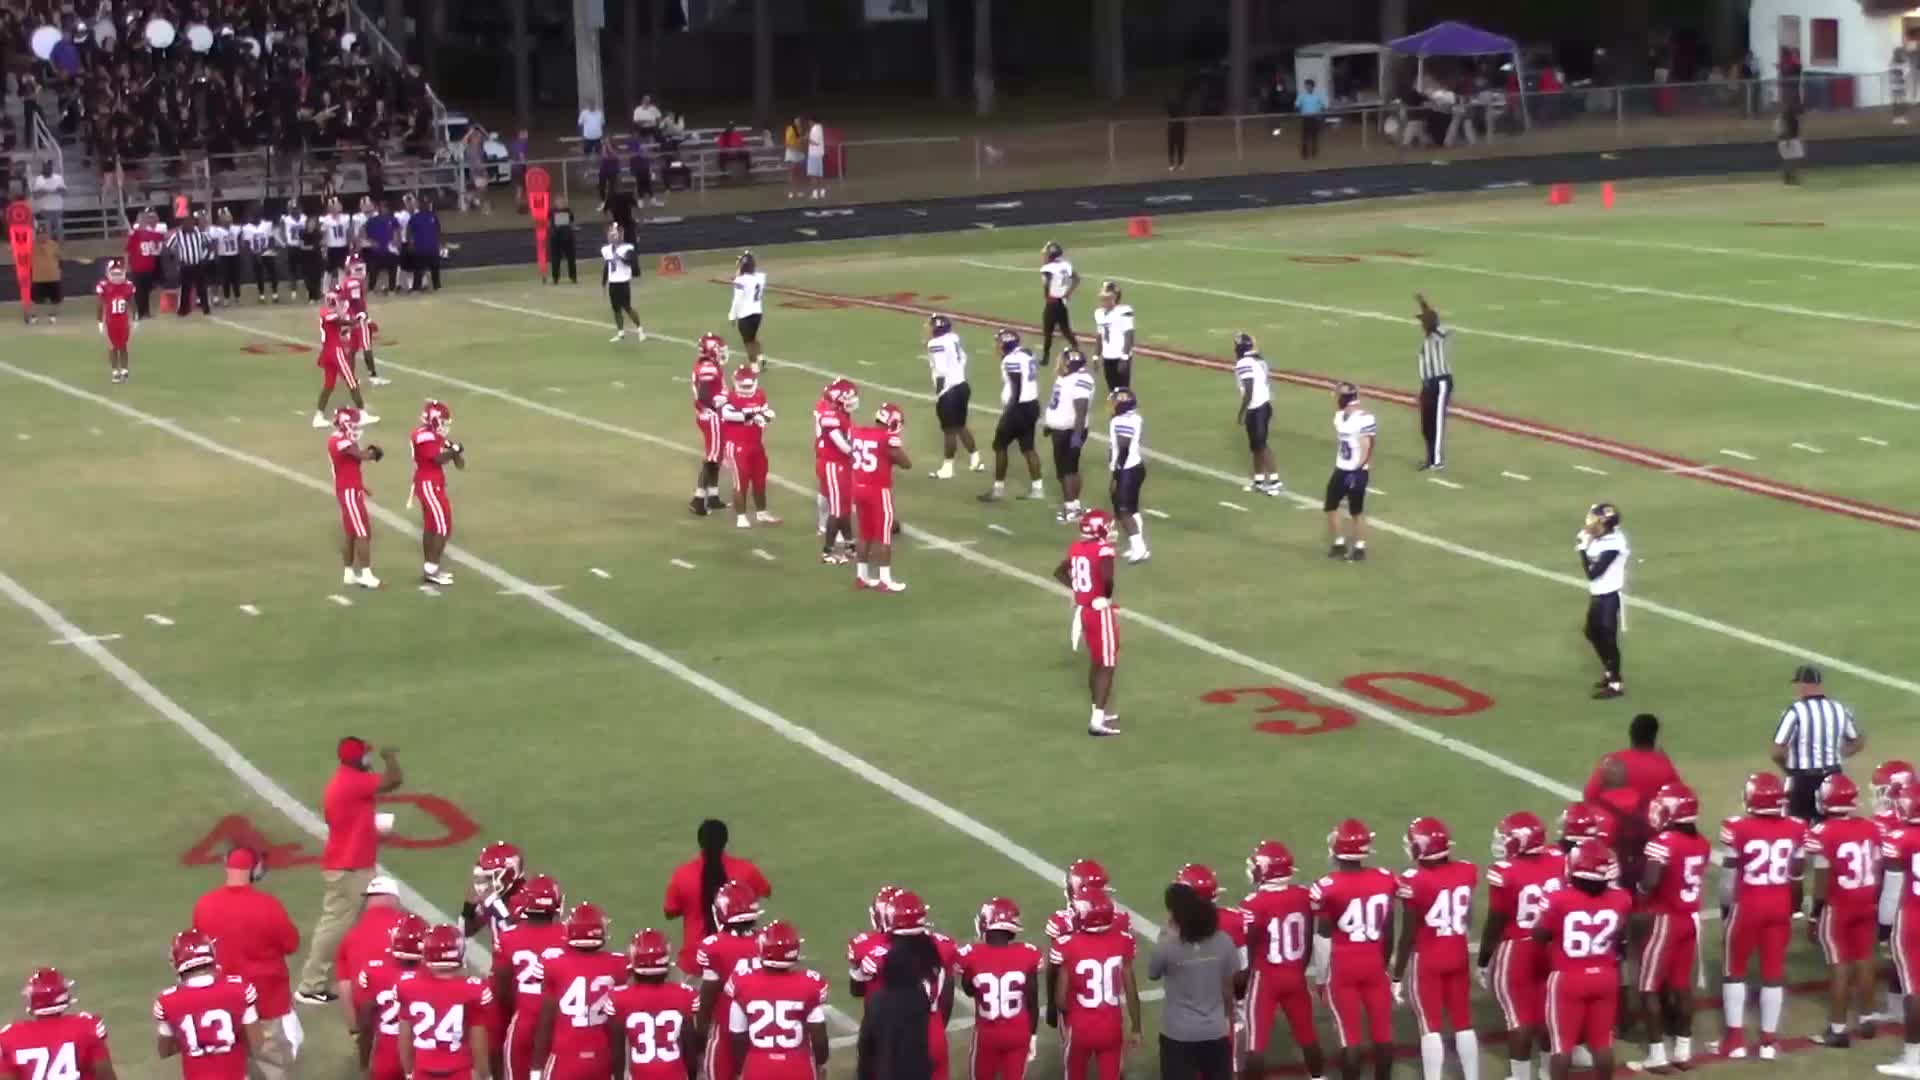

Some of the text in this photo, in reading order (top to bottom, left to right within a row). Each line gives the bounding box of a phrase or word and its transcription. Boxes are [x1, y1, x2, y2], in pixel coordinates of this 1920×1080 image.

[1202, 671, 1495, 735] 30
[1743, 838, 1793, 885] 28
[1836, 839, 1875, 890] 31
[1267, 911, 1305, 964] 10
[1337, 893, 1389, 942] 40
[1563, 909, 1618, 958] 62
[559, 975, 616, 1027] 42
[973, 970, 1026, 1020] 36
[1076, 955, 1122, 1008] 30
[180, 1011, 235, 1056] 13
[409, 1001, 463, 1052] 24
[626, 1010, 683, 1064] 33
[746, 999, 804, 1048] 25
[15, 1041, 81, 1080] 74
